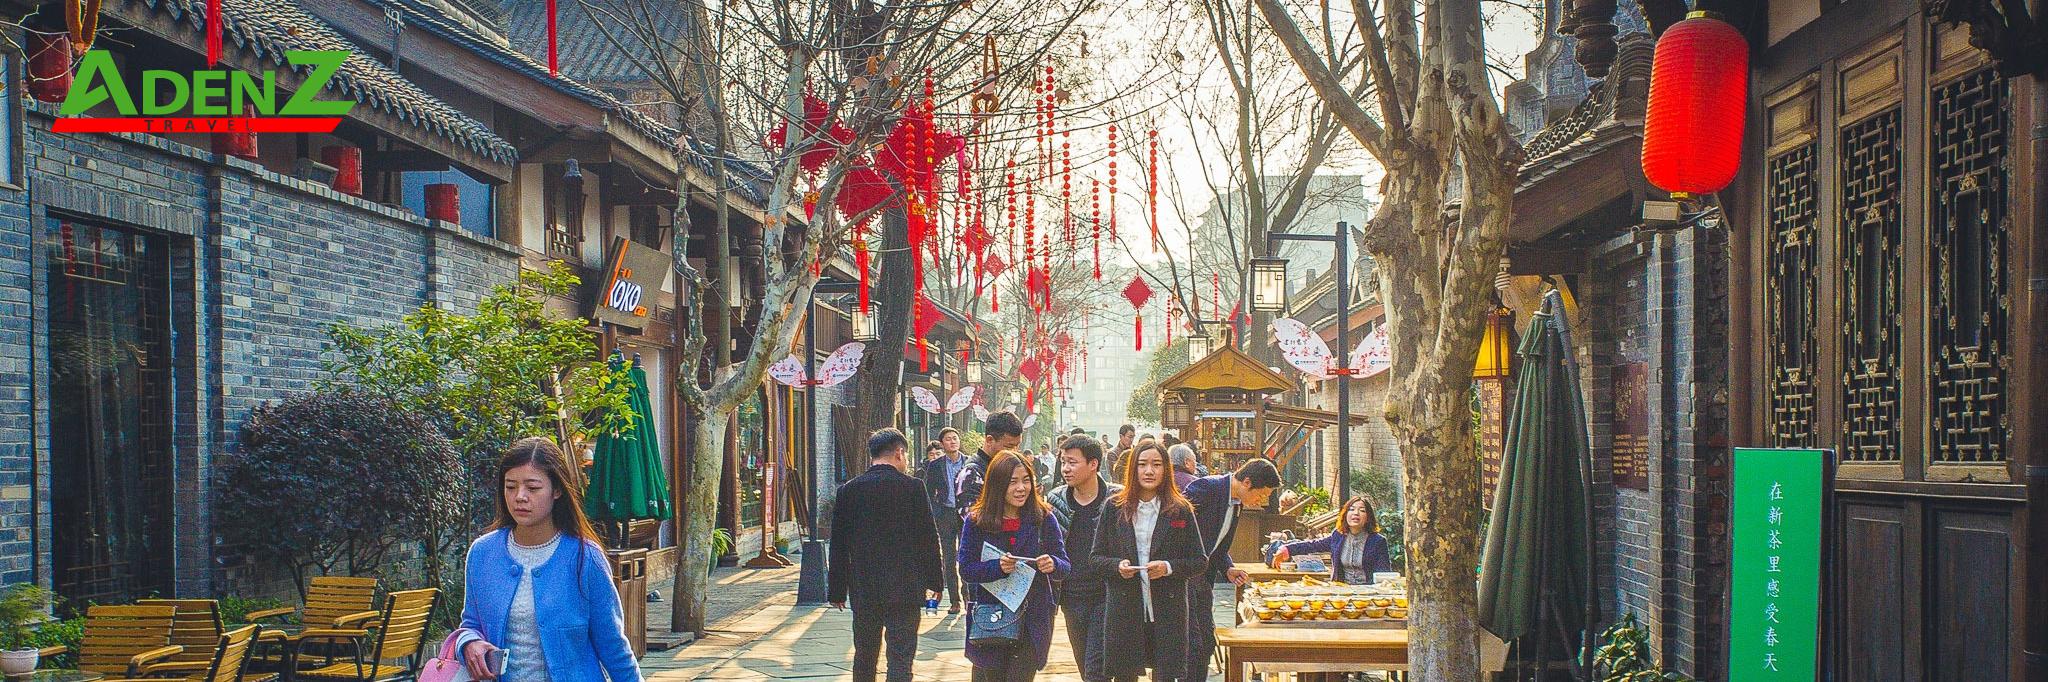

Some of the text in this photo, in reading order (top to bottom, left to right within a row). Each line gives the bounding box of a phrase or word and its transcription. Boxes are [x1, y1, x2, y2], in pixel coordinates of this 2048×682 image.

[1763, 481, 1784, 672] 在新茶里感受春天
